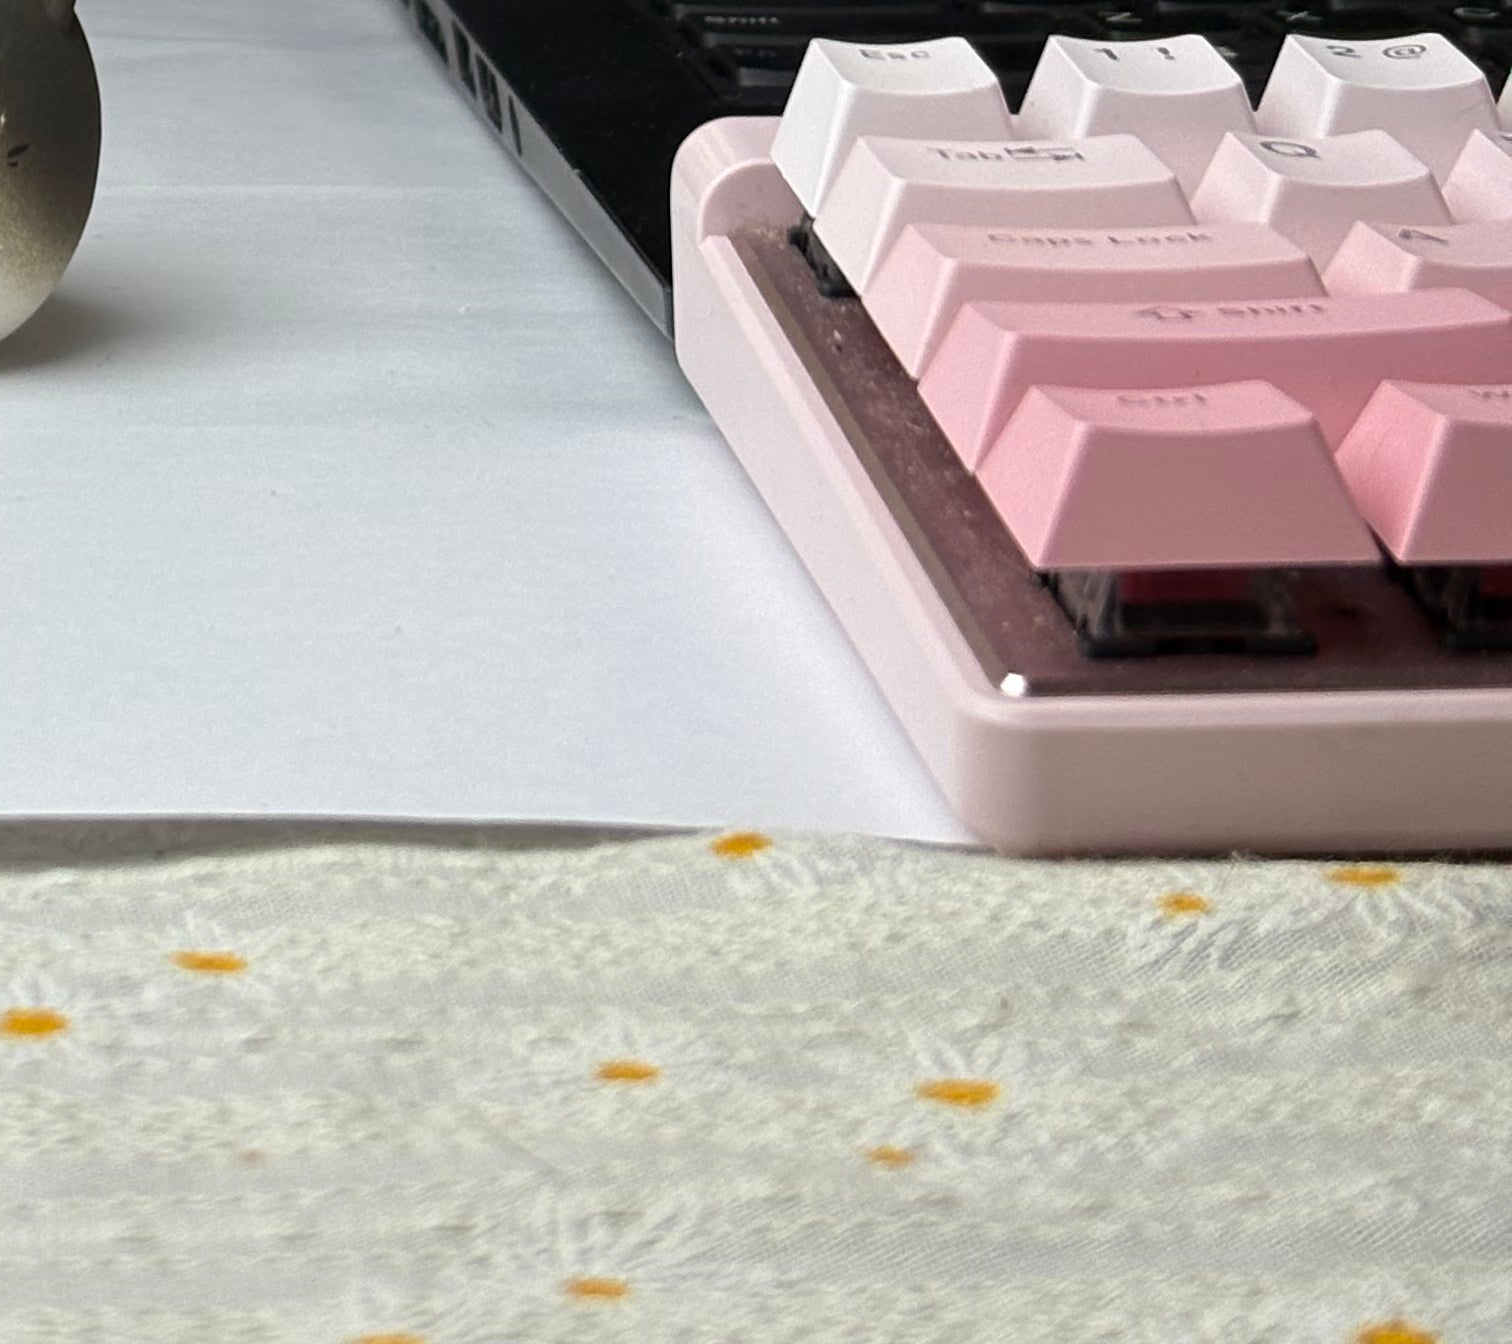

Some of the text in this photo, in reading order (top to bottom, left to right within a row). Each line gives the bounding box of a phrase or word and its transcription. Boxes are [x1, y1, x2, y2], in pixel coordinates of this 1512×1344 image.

[859, 48, 930, 60] Esc
[1094, 47, 1120, 62] 1
[1326, 43, 1427, 60] 2 @
[928, 146, 1003, 161] Tab
[1260, 140, 1321, 159] Q
[1398, 227, 1450, 244] A
